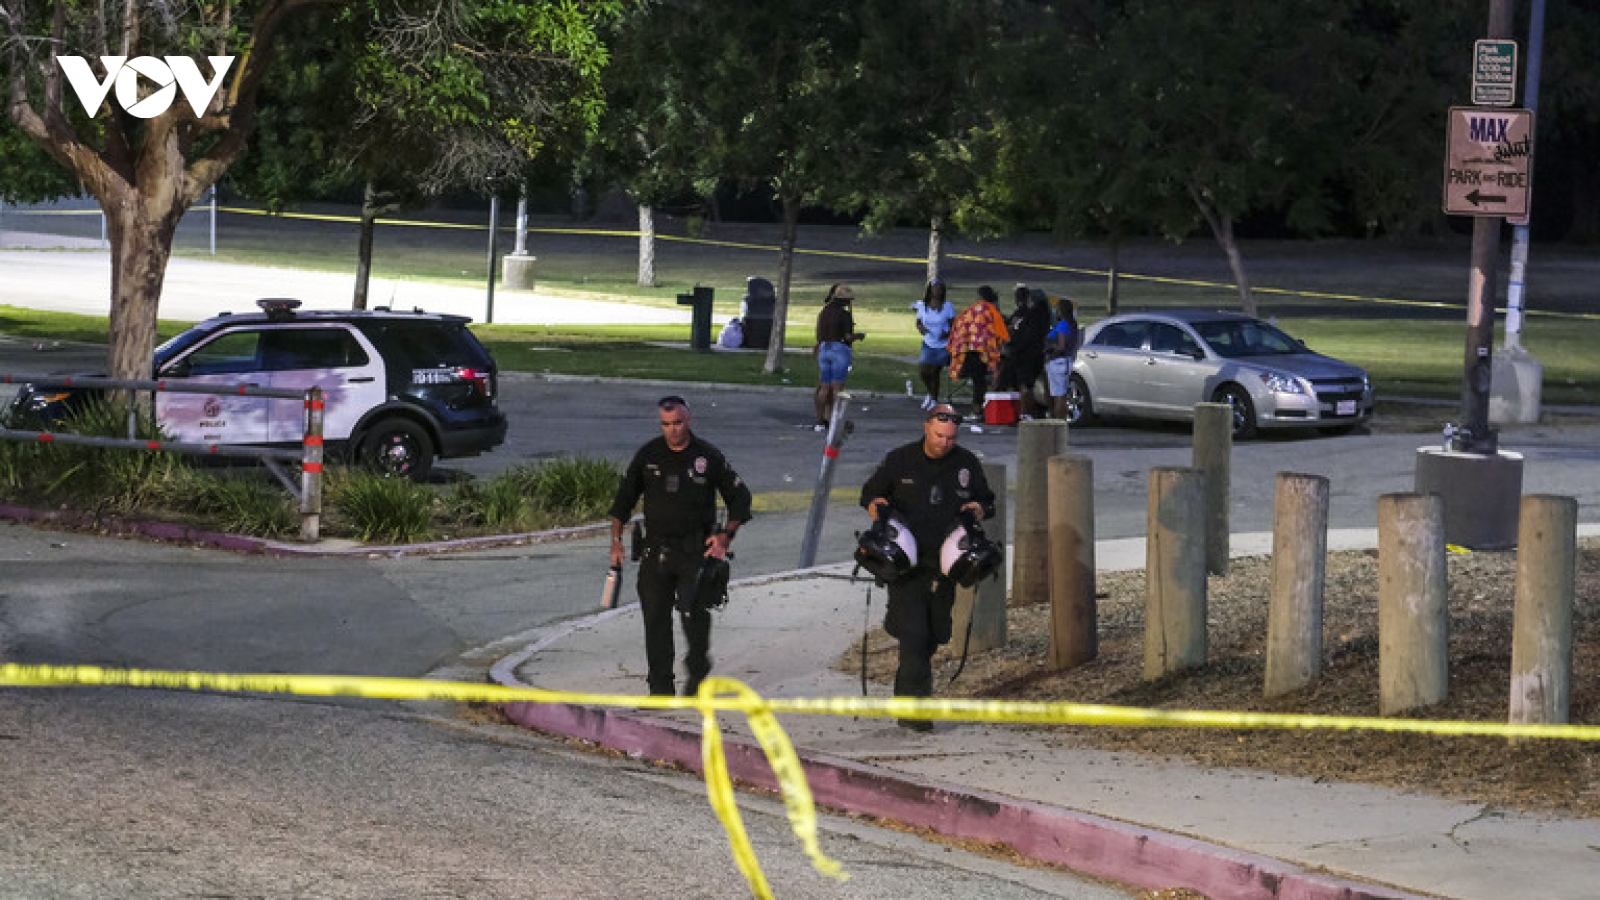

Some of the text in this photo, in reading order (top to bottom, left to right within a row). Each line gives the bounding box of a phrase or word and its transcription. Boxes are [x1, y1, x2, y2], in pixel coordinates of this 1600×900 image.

[1470, 117, 1509, 143] MAX
[1449, 169, 1482, 185] PARK
[1498, 171, 1526, 188] RIDE
